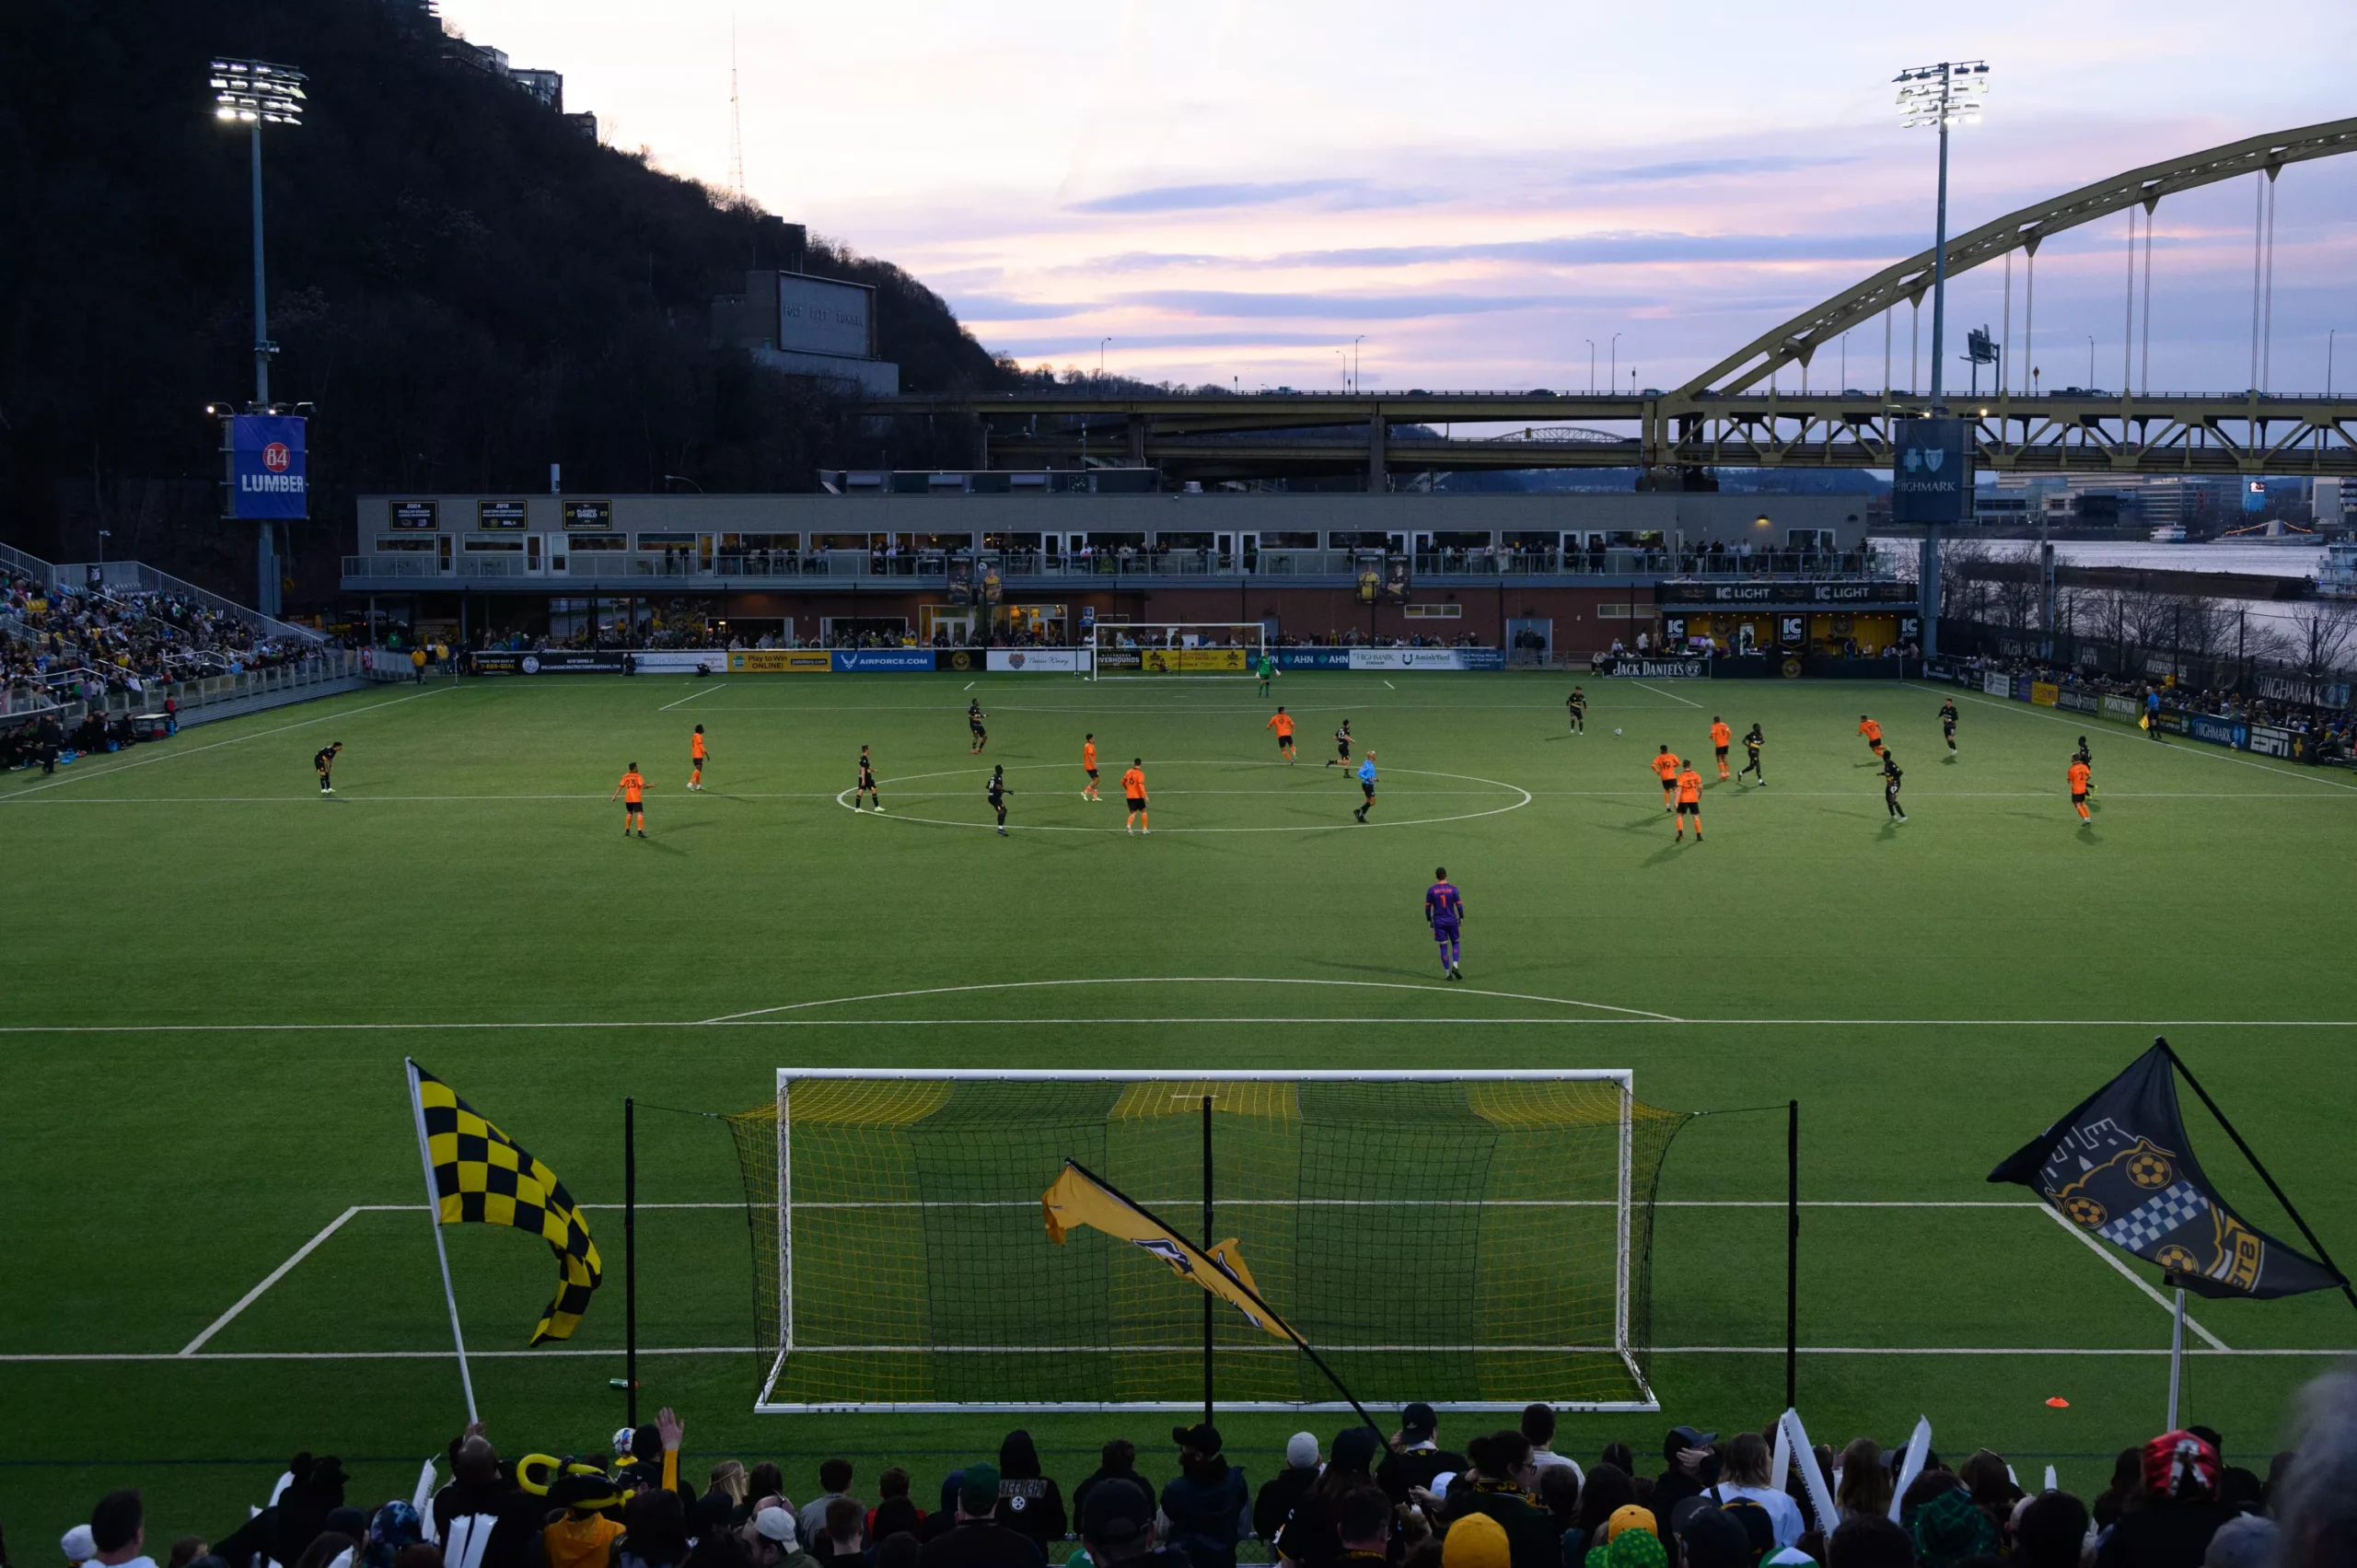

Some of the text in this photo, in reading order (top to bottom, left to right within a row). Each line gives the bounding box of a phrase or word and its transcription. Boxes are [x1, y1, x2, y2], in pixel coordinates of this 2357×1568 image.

[267, 448, 287, 467] 84
[242, 474, 304, 493] LUMBER
[1897, 480, 1956, 493] HIGHMARK
[1716, 587, 1731, 599] IC
[1734, 588, 1770, 599] LIGHT
[1815, 587, 1830, 599] IC
[1833, 587, 1869, 598] LIGHT
[1667, 619, 1684, 633] IC
[1782, 618, 1802, 633] IC
[1901, 618, 1918, 633] IC
[859, 657, 927, 666] AIRFORCE.COM
[1294, 655, 1314, 664] AHN
[1329, 655, 1349, 664] AHN
[1612, 660, 1684, 676] JACK DANIEL'S
[2104, 696, 2136, 715] POINT PARK
[2195, 721, 2232, 743] HIGHMARK
[1662, 761, 1671, 771] 19
[625, 779, 636, 789] 23
[1129, 776, 1135, 785] 6
[1686, 779, 1697, 789] 33
[1440, 894, 1446, 910] 1
